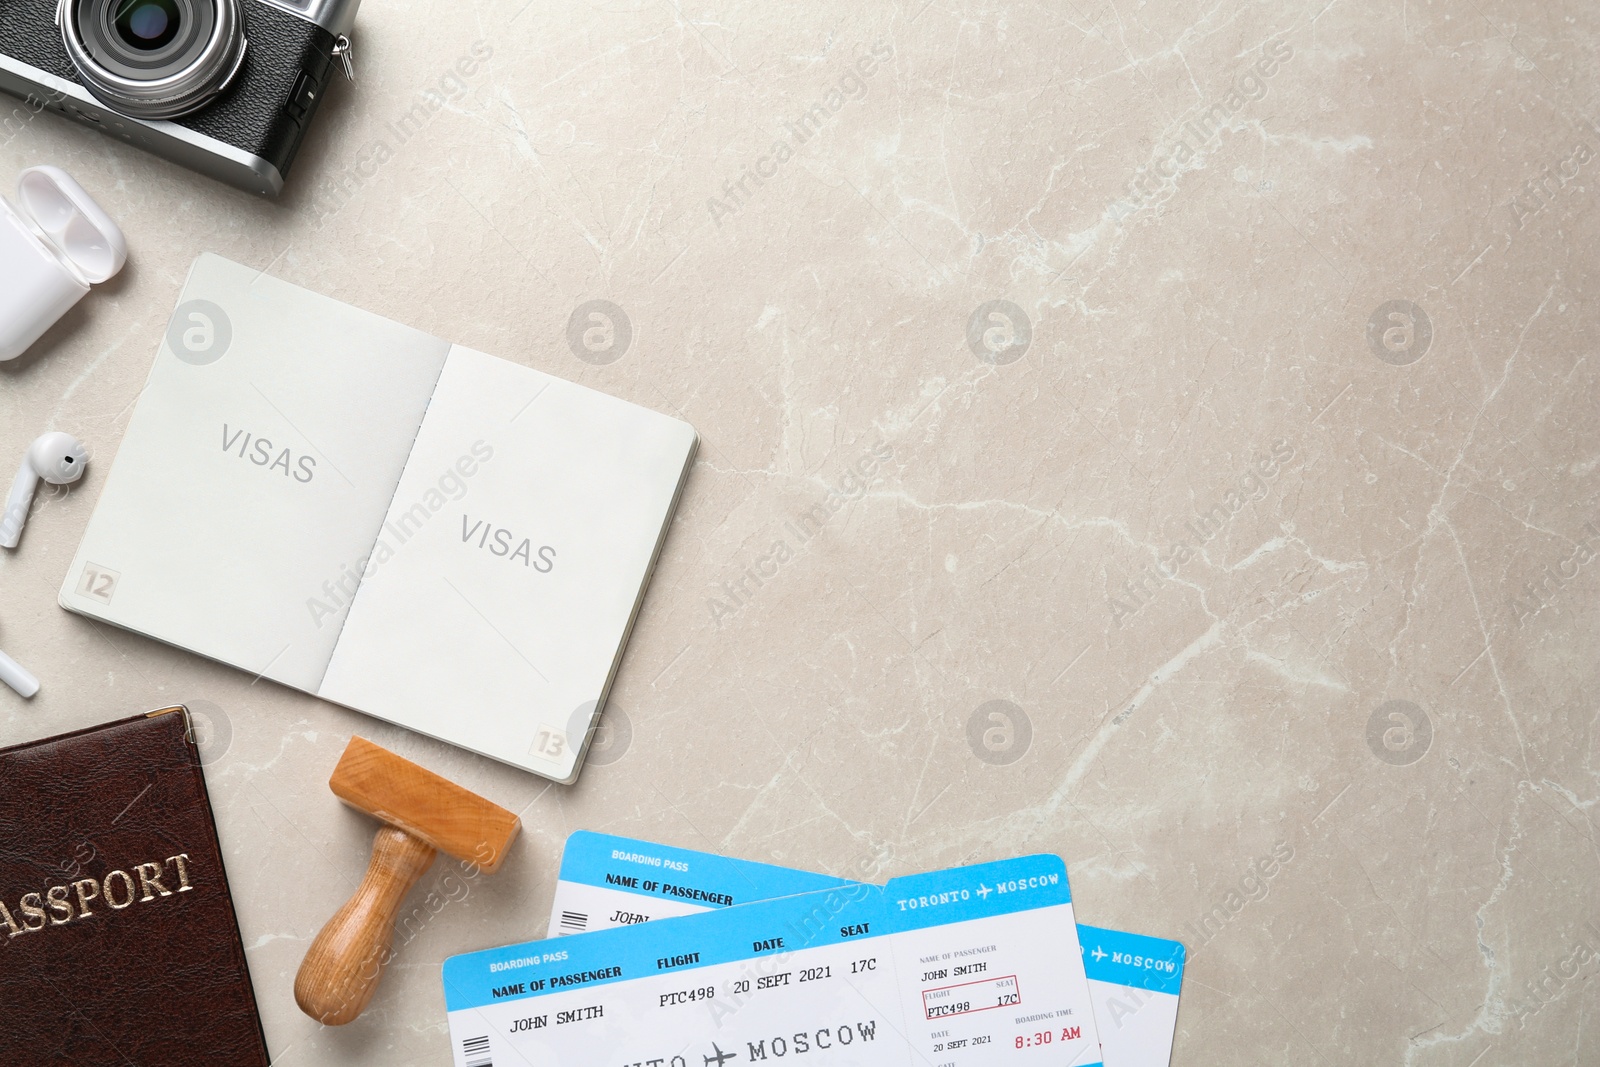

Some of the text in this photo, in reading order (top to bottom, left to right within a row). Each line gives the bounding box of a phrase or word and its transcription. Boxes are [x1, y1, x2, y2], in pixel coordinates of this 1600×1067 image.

[222, 423, 316, 483] VISAS
[462, 514, 556, 574] VISAS
[85, 569, 114, 598] 12
[539, 730, 564, 757] 13
[612, 850, 689, 872] BOARDING PASS
[605, 873, 733, 906] NAME OF PASSENGER
[897, 873, 1059, 911] TORONTO MOSCOW
[840, 923, 870, 937] SEAT
[753, 938, 785, 952] DATE
[919, 945, 997, 964] NAME OF PASSENGER
[490, 951, 569, 973] BOARDING PASS
[657, 953, 700, 969] FLIGHT
[851, 958, 877, 974] 17C
[1112, 951, 1175, 973] MOSCOW
[492, 966, 622, 998] NAME OF PASSENGER
[734, 966, 832, 994] 20 SEPT 2021
[921, 962, 987, 982] JOHN SMITH
[996, 979, 1014, 988] SEAT
[659, 986, 715, 1007] PTC498
[924, 990, 951, 1000] FLIGHT
[997, 994, 1018, 1006] 17C
[510, 1005, 604, 1033] JOHN SMITH
[928, 1002, 970, 1017] PTC498
[1015, 1008, 1073, 1024] BOARDING TIME
[747, 1020, 876, 1062] MOSCOW
[931, 1030, 950, 1039] DATE
[933, 1035, 991, 1052] 20 SEPT 2021
[1015, 1026, 1081, 1049] 8:30 AM
